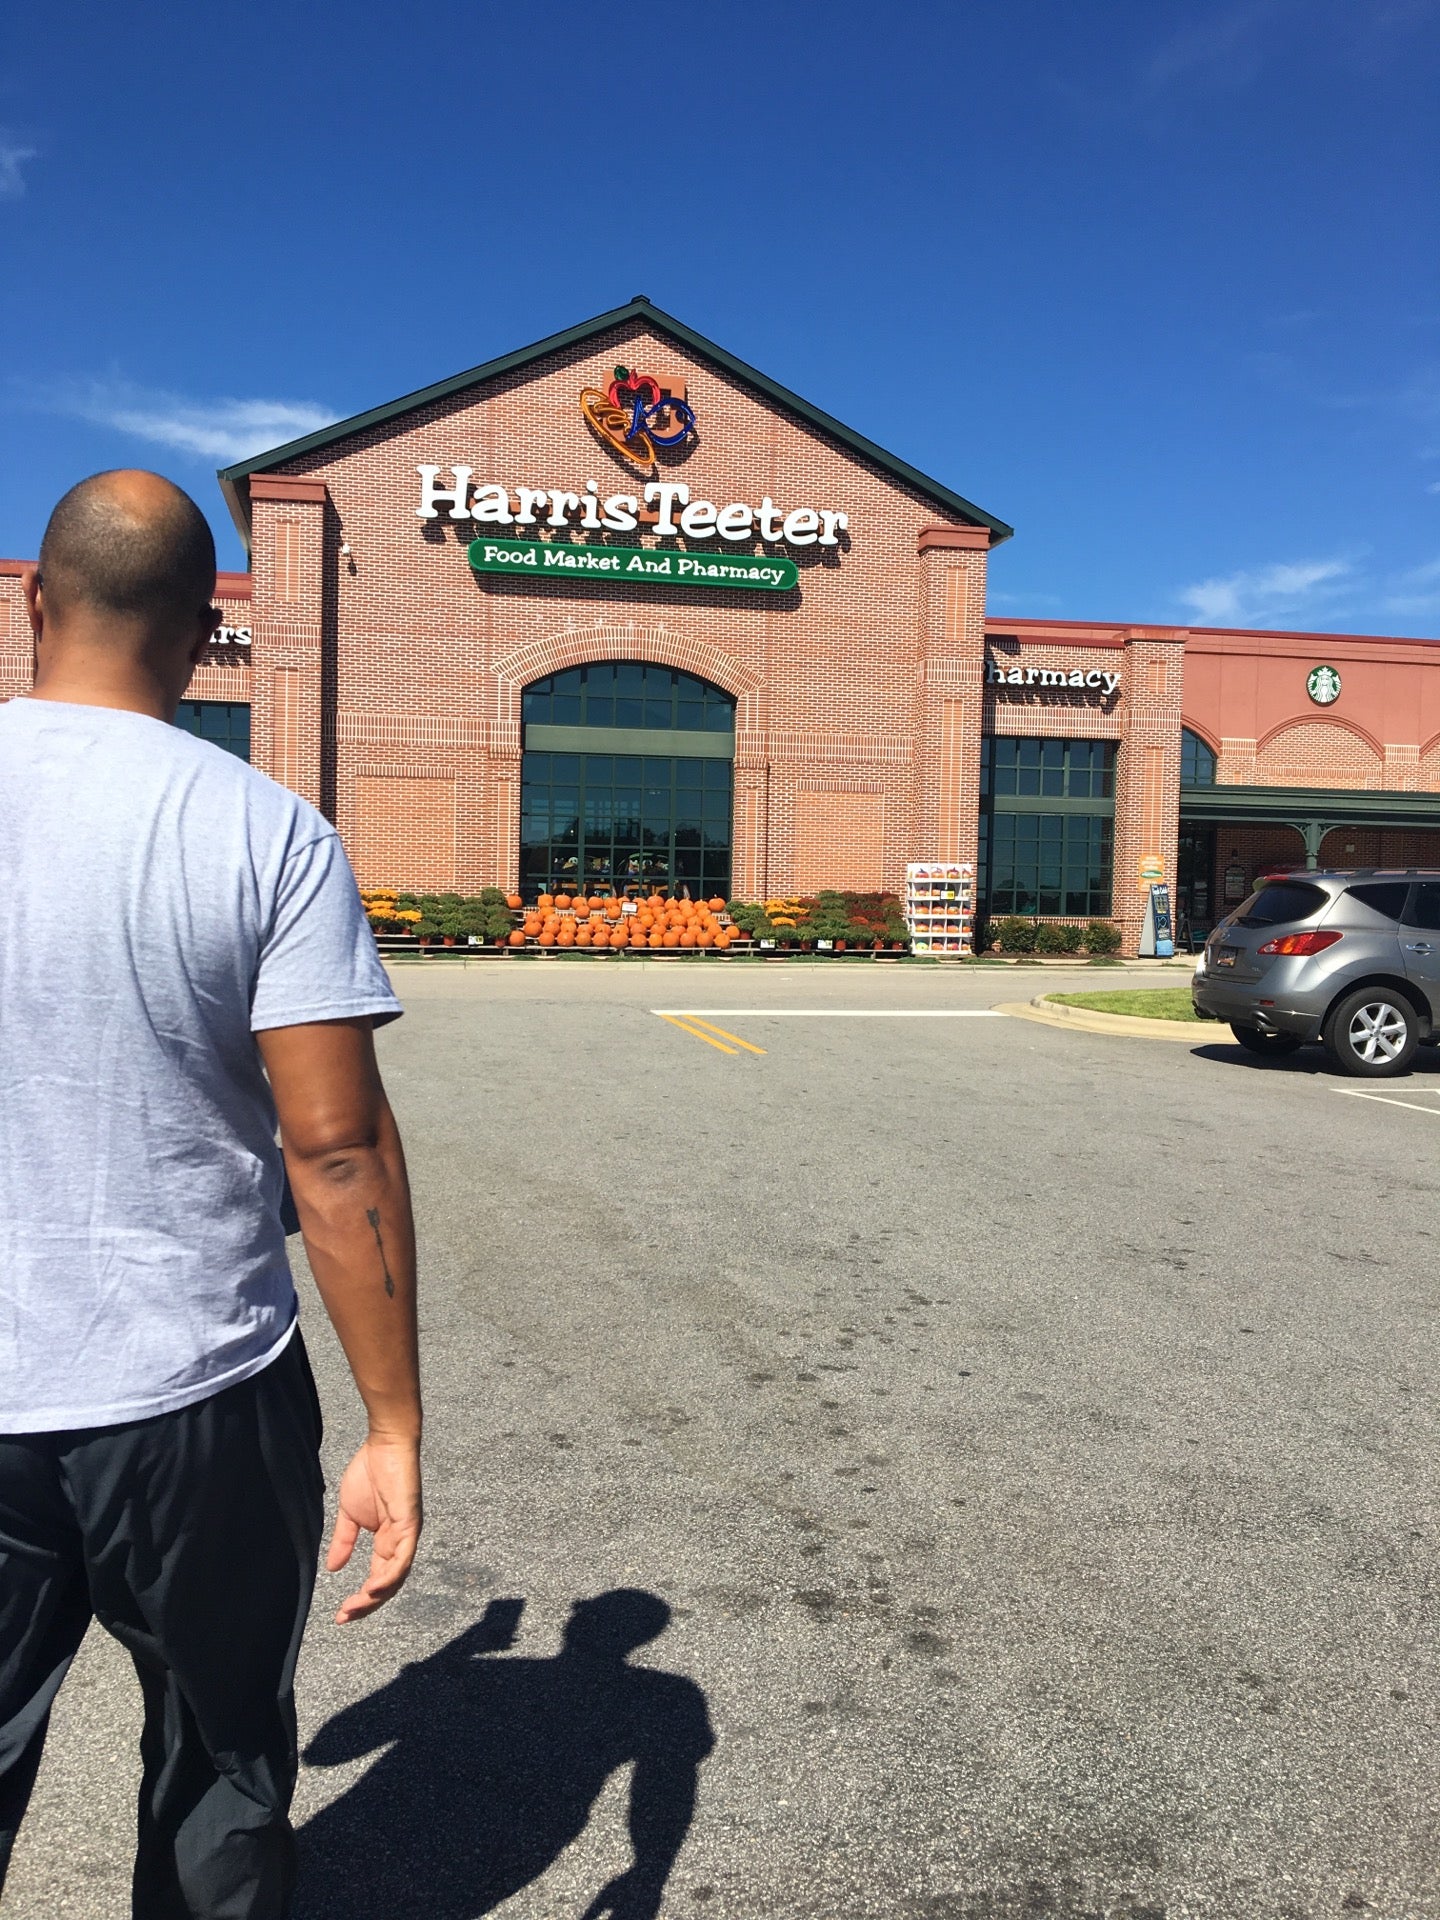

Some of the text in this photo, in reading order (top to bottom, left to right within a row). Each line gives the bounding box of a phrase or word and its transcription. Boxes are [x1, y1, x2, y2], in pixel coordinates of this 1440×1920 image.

[416, 465, 848, 546] Harris Teeter
[484, 546, 785, 584] Food Market And Pharmacy
[209, 626, 252, 645] rs
